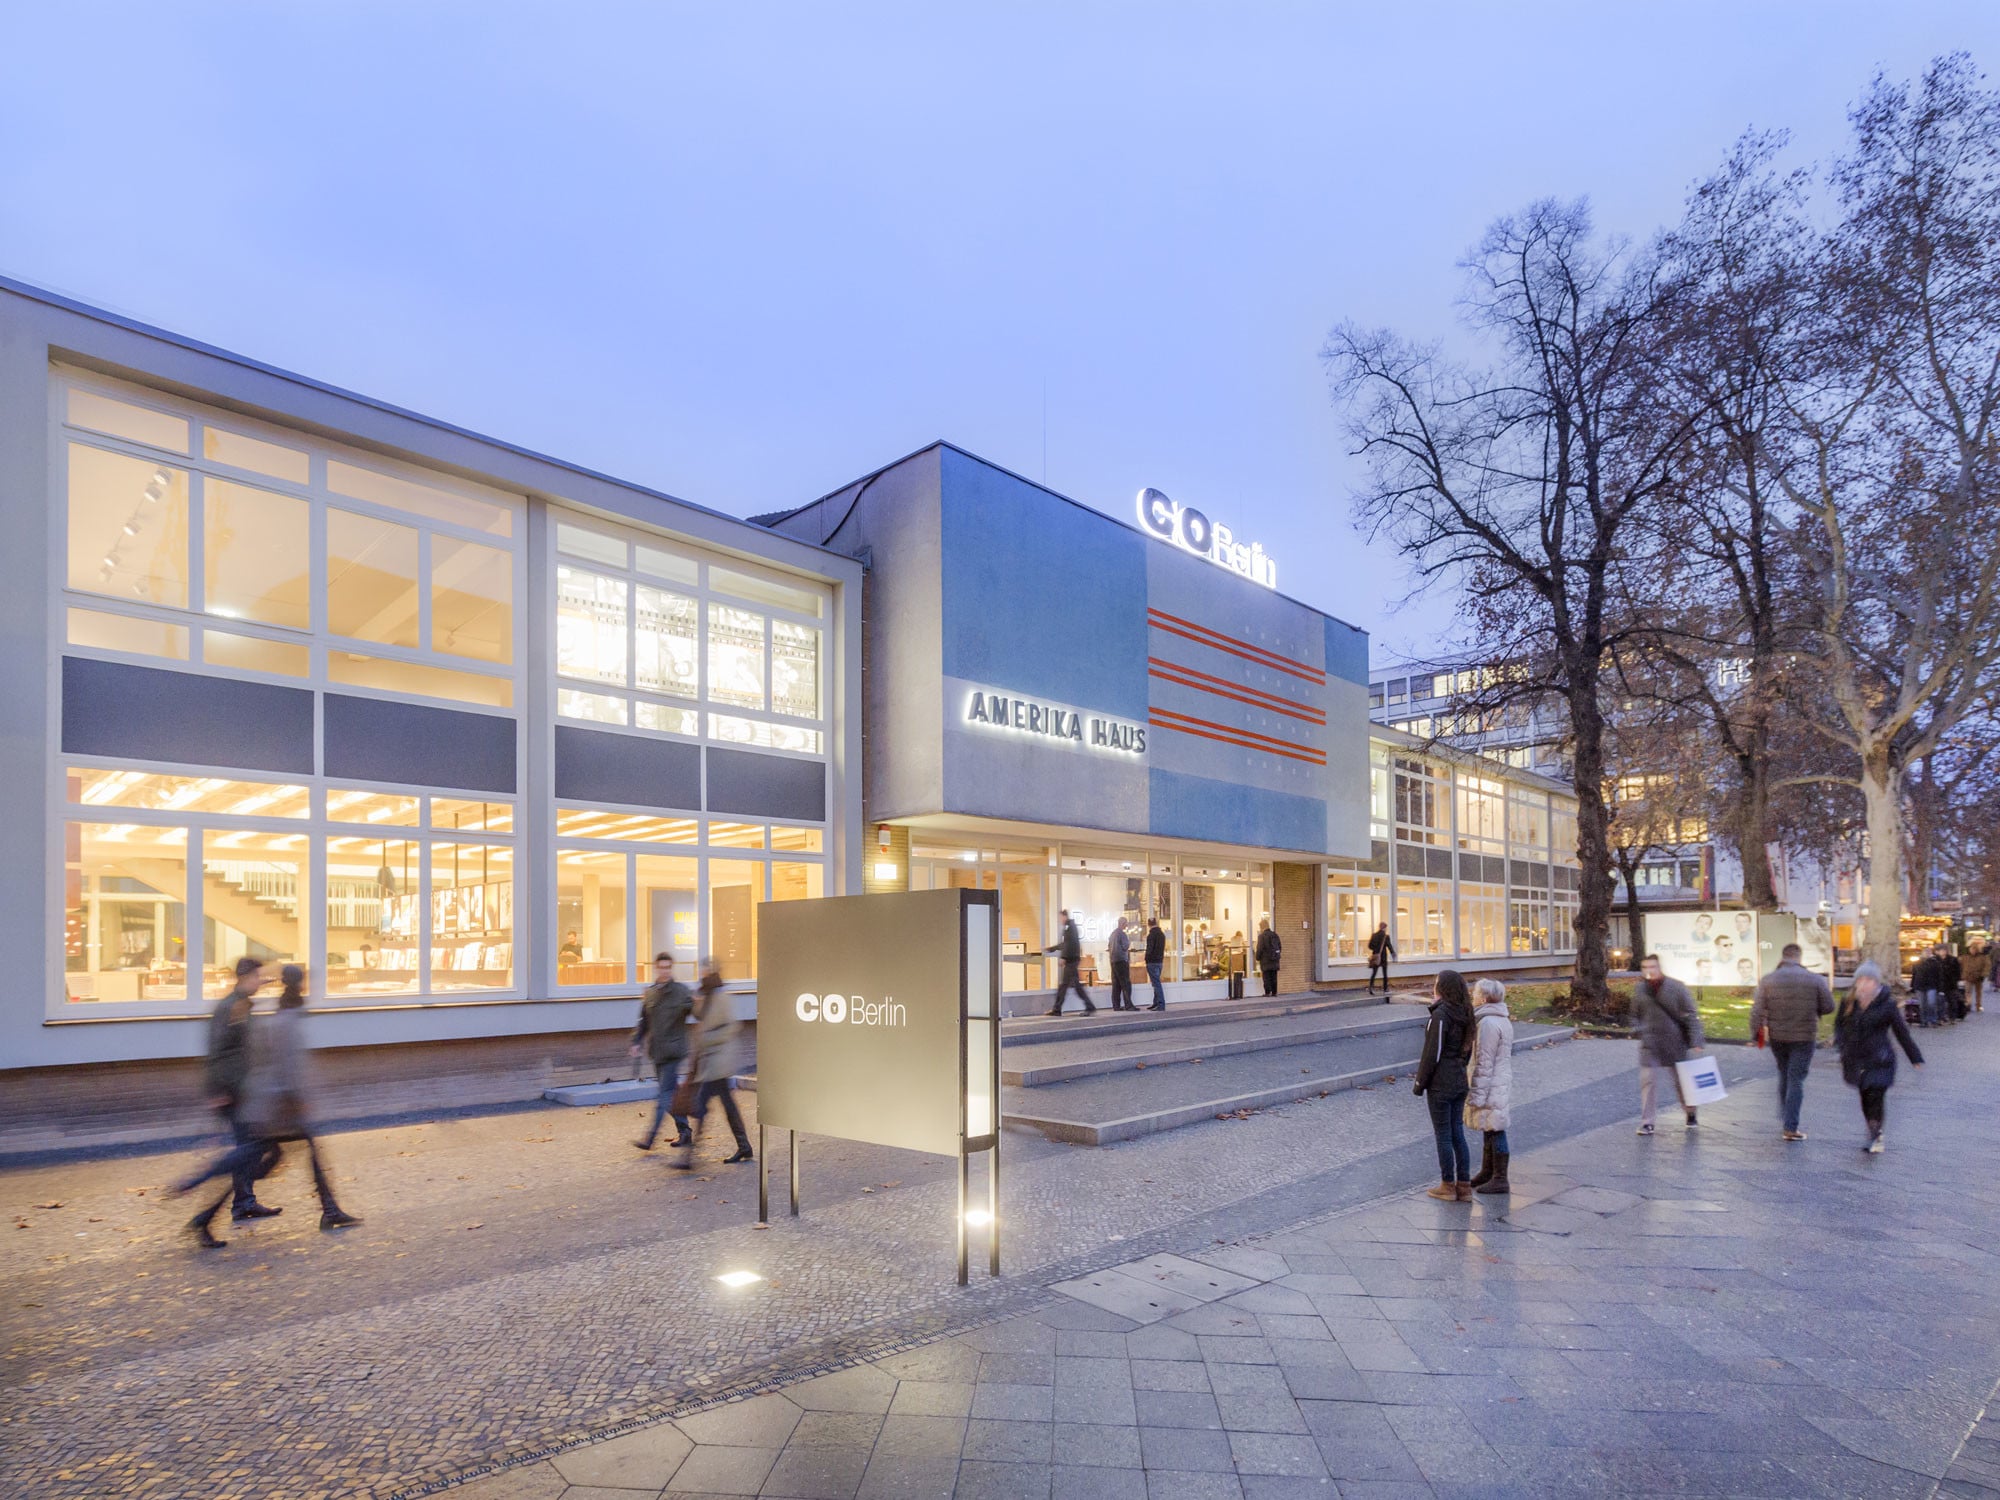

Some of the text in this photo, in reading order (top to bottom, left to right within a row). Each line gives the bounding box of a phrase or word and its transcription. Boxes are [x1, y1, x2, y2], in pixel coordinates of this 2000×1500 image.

[967, 691, 1147, 753] AMERIKA HAUS
[1655, 942, 1687, 951] Picture
[851, 995, 906, 1027] Berlin
